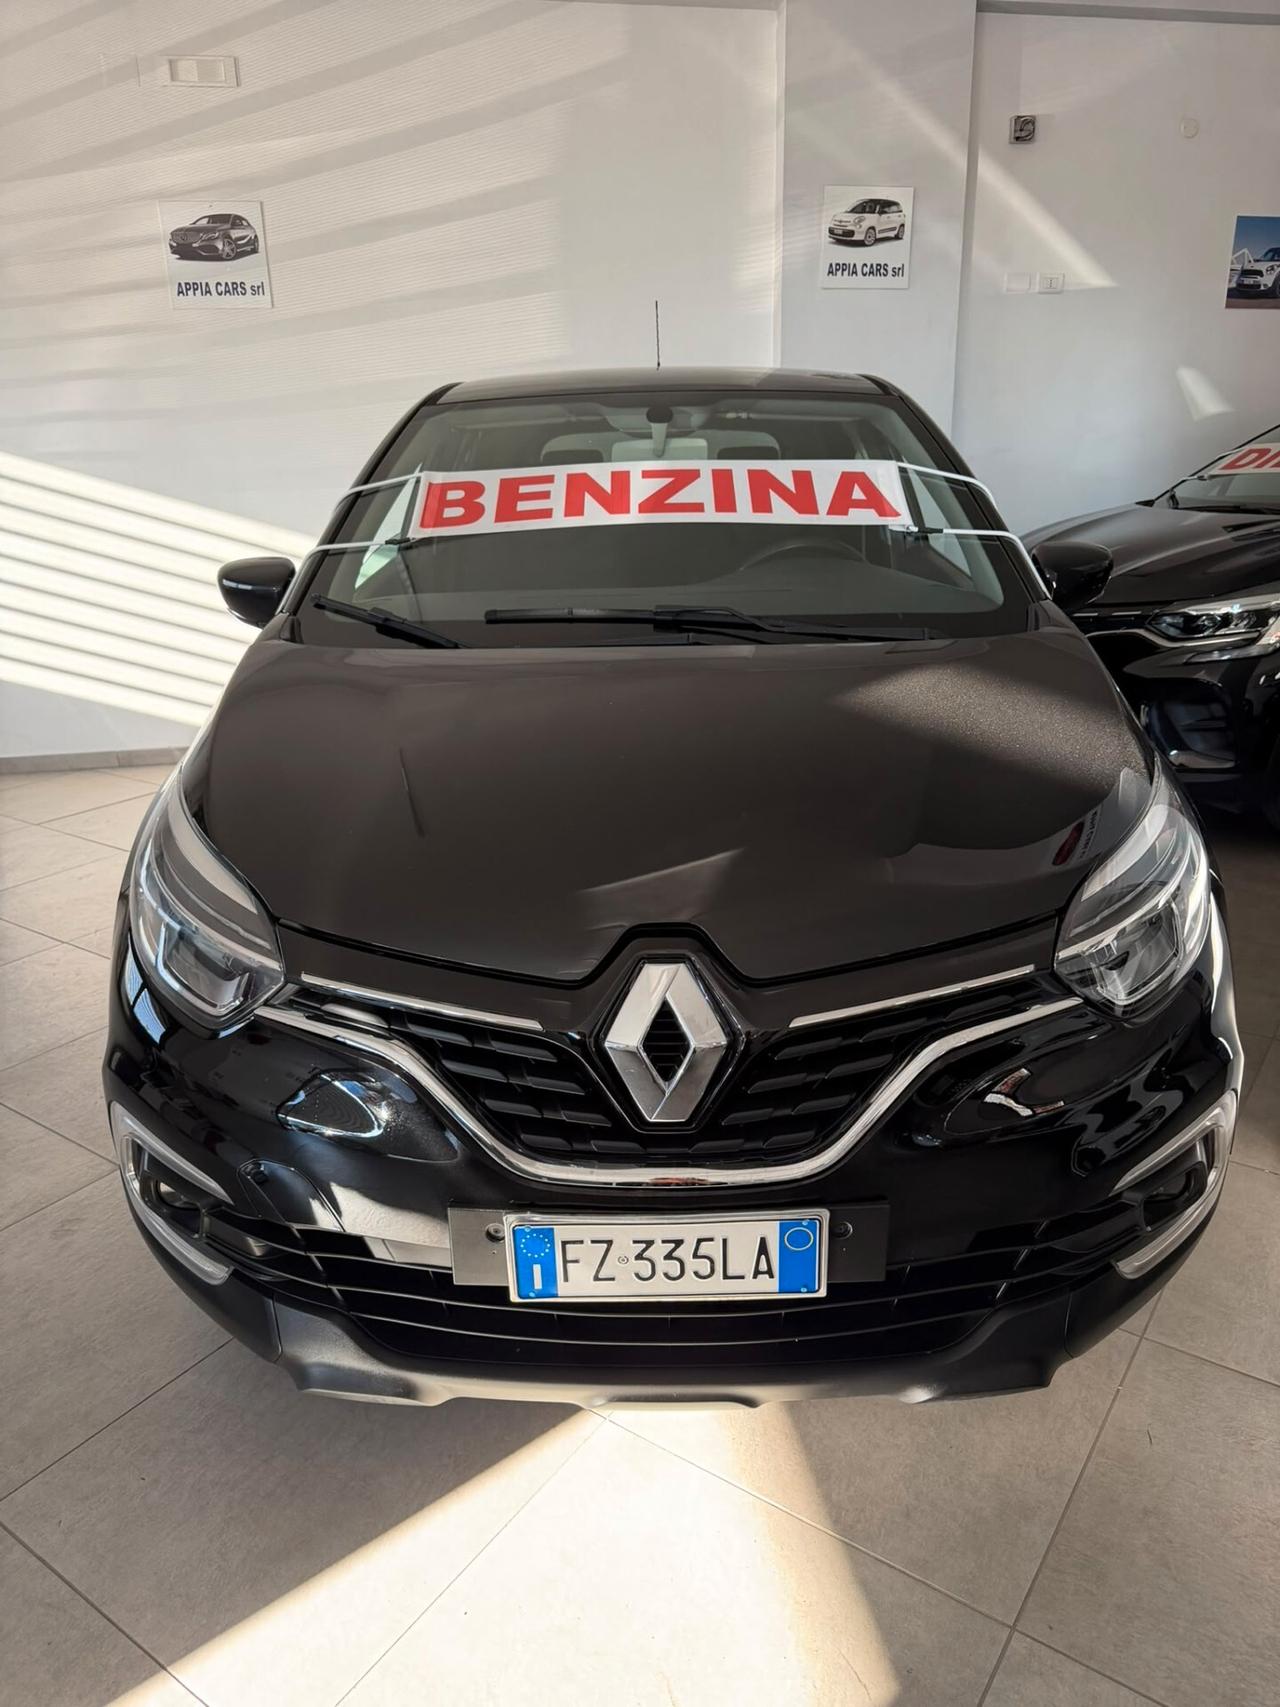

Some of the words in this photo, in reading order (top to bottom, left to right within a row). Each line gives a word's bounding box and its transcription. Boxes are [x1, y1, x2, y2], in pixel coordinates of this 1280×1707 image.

[827, 262, 858, 277] APPIA
[861, 262, 889, 277] CARS
[891, 263, 905, 277] srl
[177, 281, 212, 296] APPIA
[215, 281, 247, 296] CARS
[250, 281, 265, 296] srl
[1218, 448, 1280, 470] DI
[419, 468, 902, 529] BENZINA
